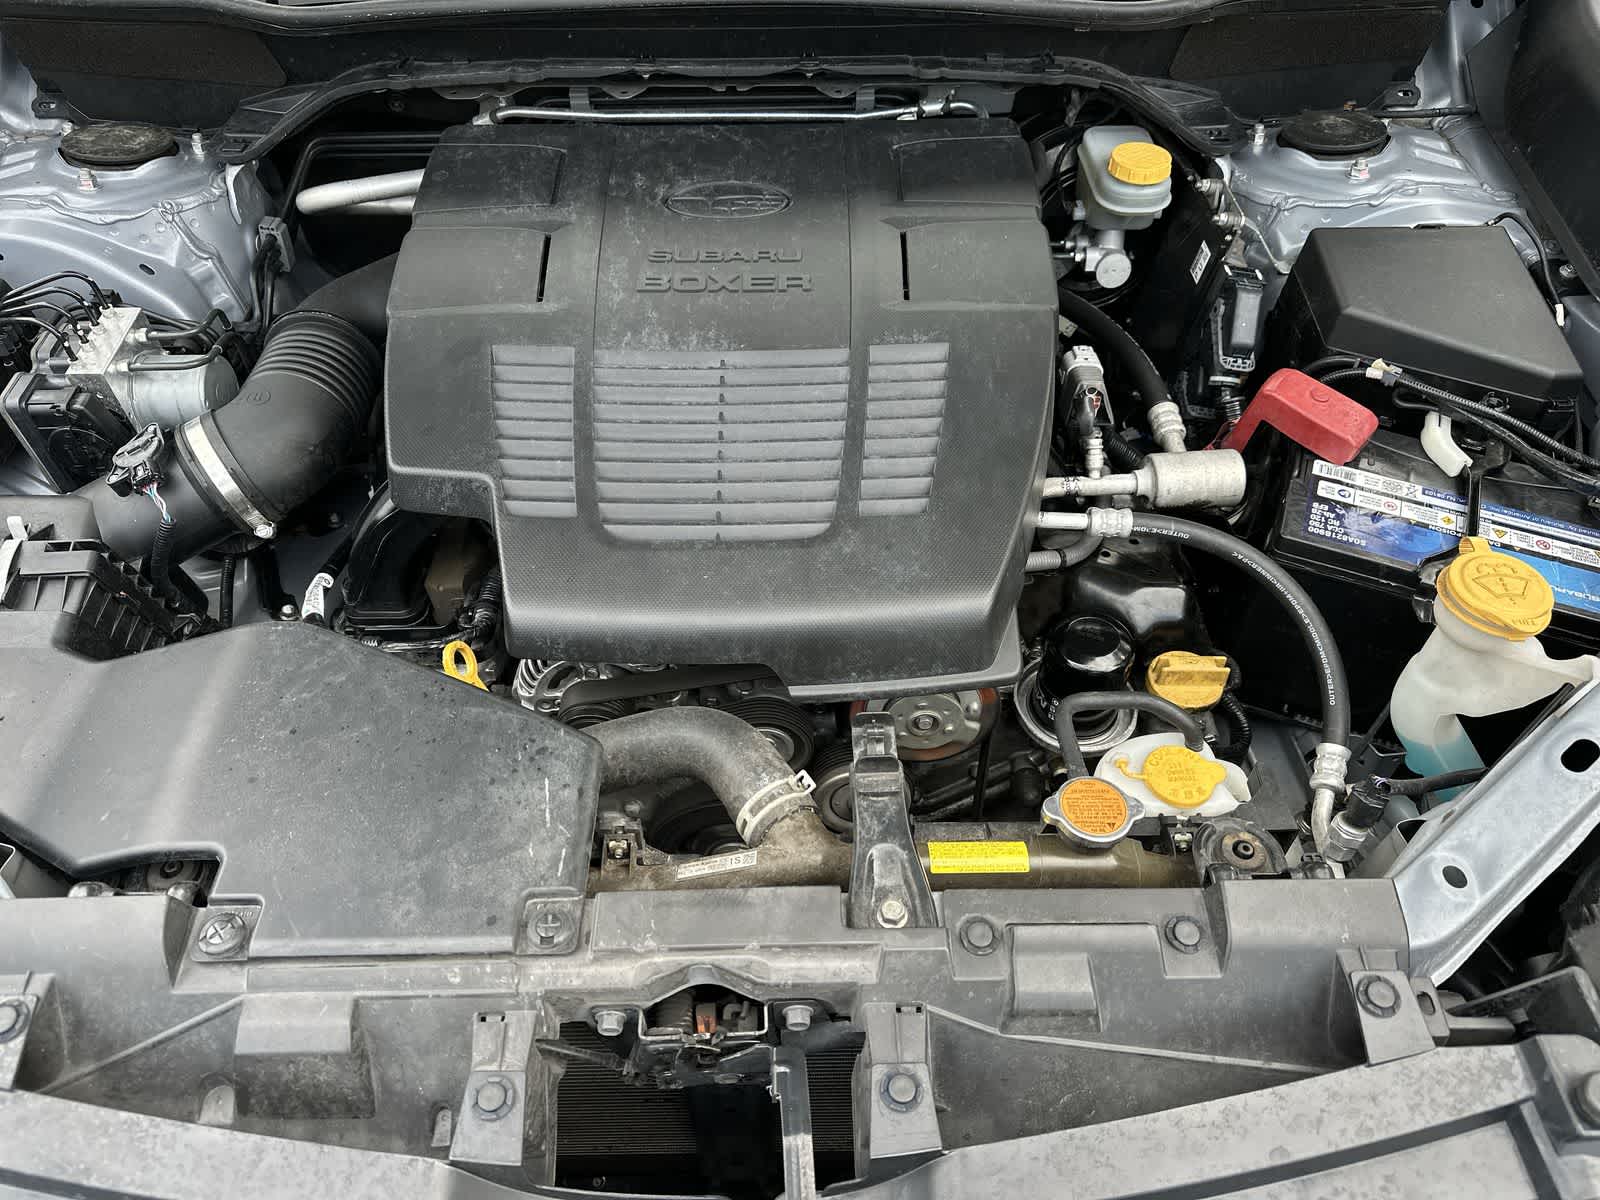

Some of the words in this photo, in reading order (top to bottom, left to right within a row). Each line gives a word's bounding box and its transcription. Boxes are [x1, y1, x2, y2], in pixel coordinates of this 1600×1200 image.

[647, 246, 803, 263] SUBARU
[636, 272, 815, 293] BOXER
[1428, 524, 1462, 537] POISON
